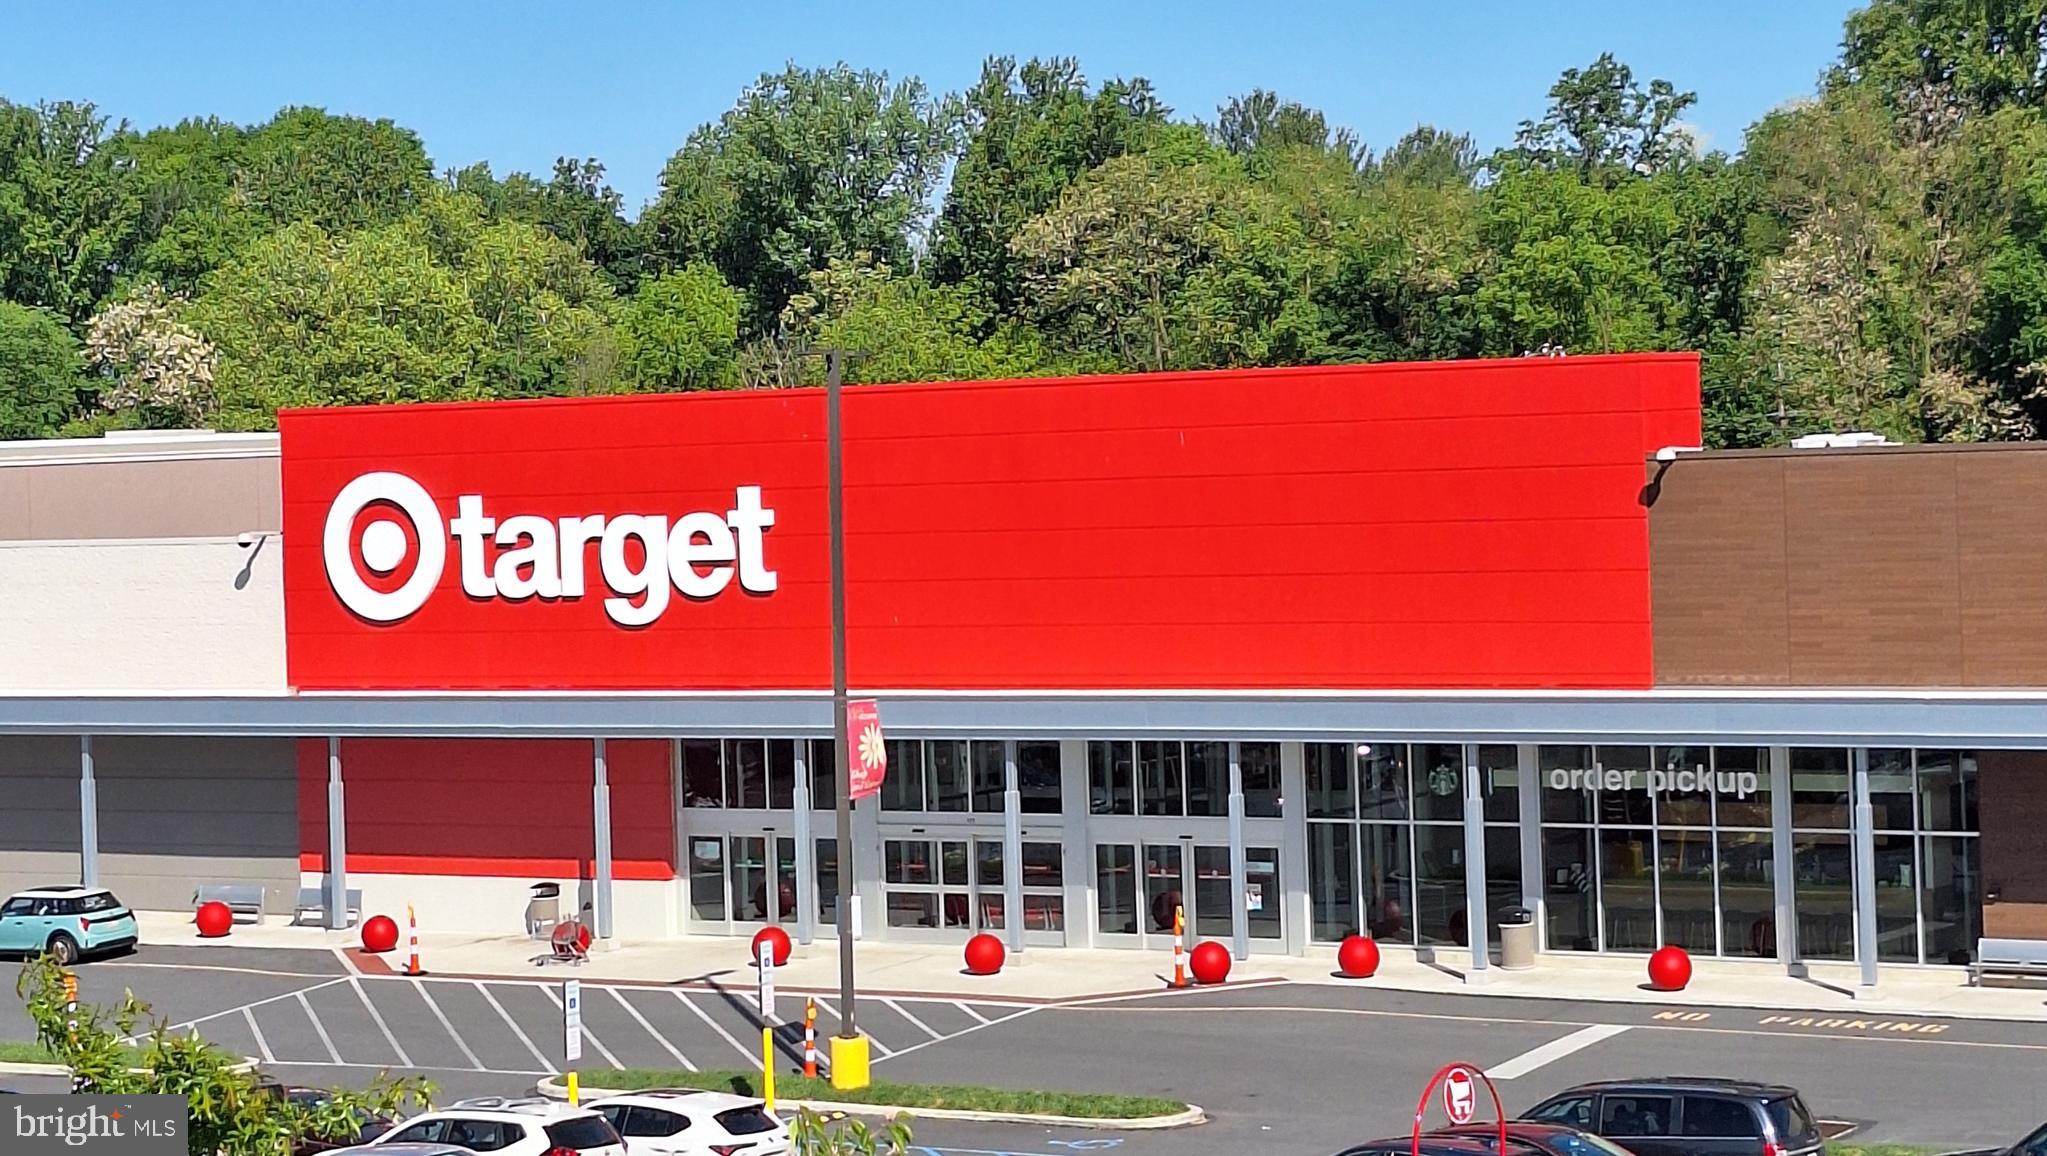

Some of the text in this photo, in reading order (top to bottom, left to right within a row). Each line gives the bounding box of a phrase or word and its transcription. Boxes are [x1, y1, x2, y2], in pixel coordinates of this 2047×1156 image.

[450, 485, 778, 629] target
[1549, 762, 1758, 799] order pickup
[1651, 1010, 1950, 1035] NO PARKING
